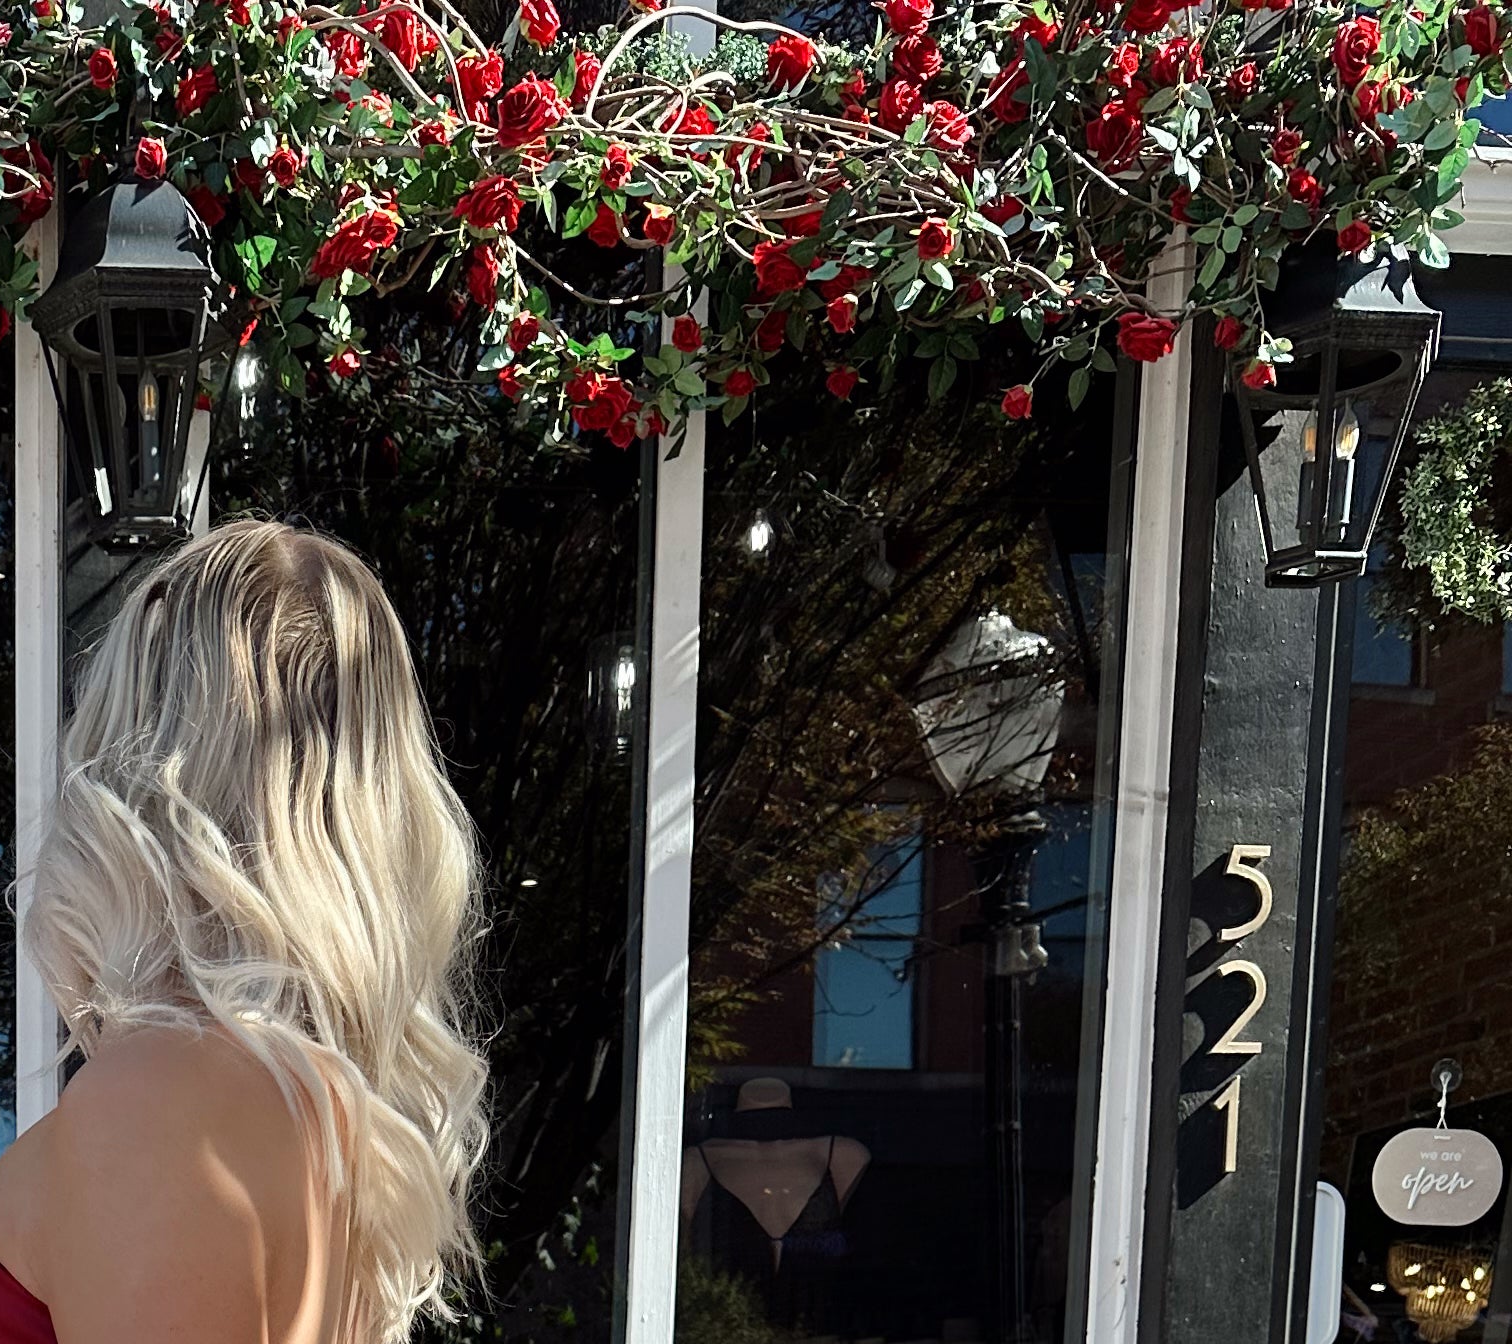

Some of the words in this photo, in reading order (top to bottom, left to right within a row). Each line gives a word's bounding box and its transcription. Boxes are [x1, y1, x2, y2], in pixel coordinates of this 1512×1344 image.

[1208, 844, 1273, 1173] 521
[1420, 1151, 1438, 1162] we
[1440, 1151, 1462, 1162] are
[1401, 1166, 1474, 1210] open
